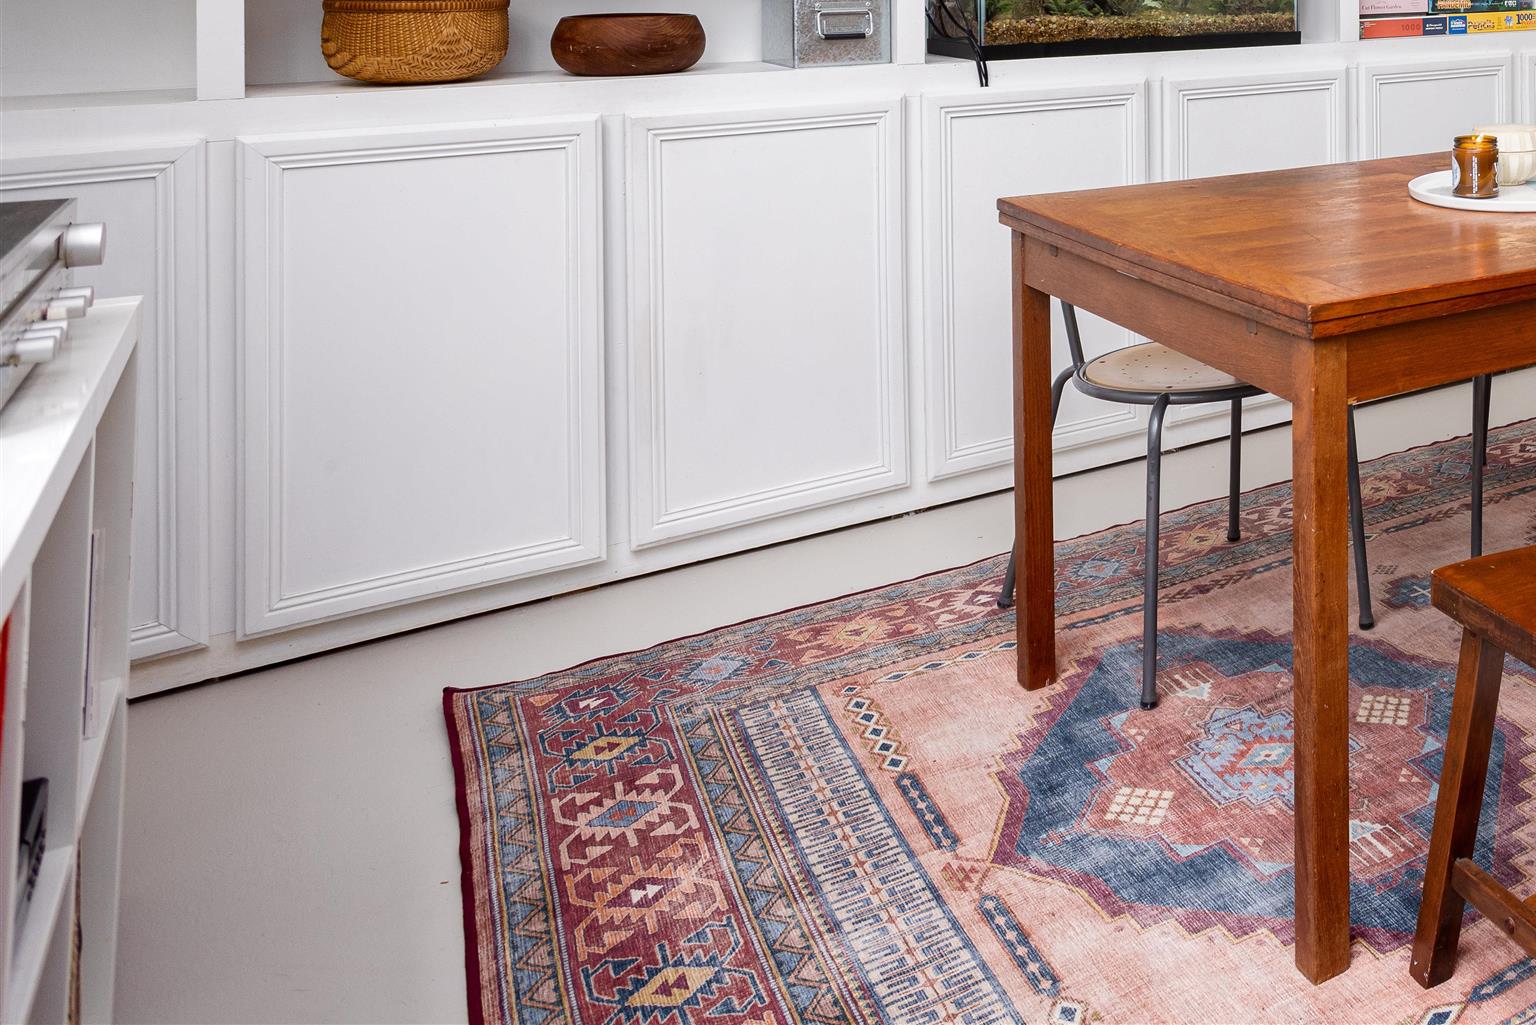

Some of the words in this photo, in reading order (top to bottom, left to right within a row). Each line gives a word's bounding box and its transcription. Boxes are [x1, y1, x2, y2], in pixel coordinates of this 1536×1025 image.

[1436, 0, 1472, 10] PANDEMIC
[1516, 14, 1532, 24] 1000
[1401, 24, 1420, 32] 1000
